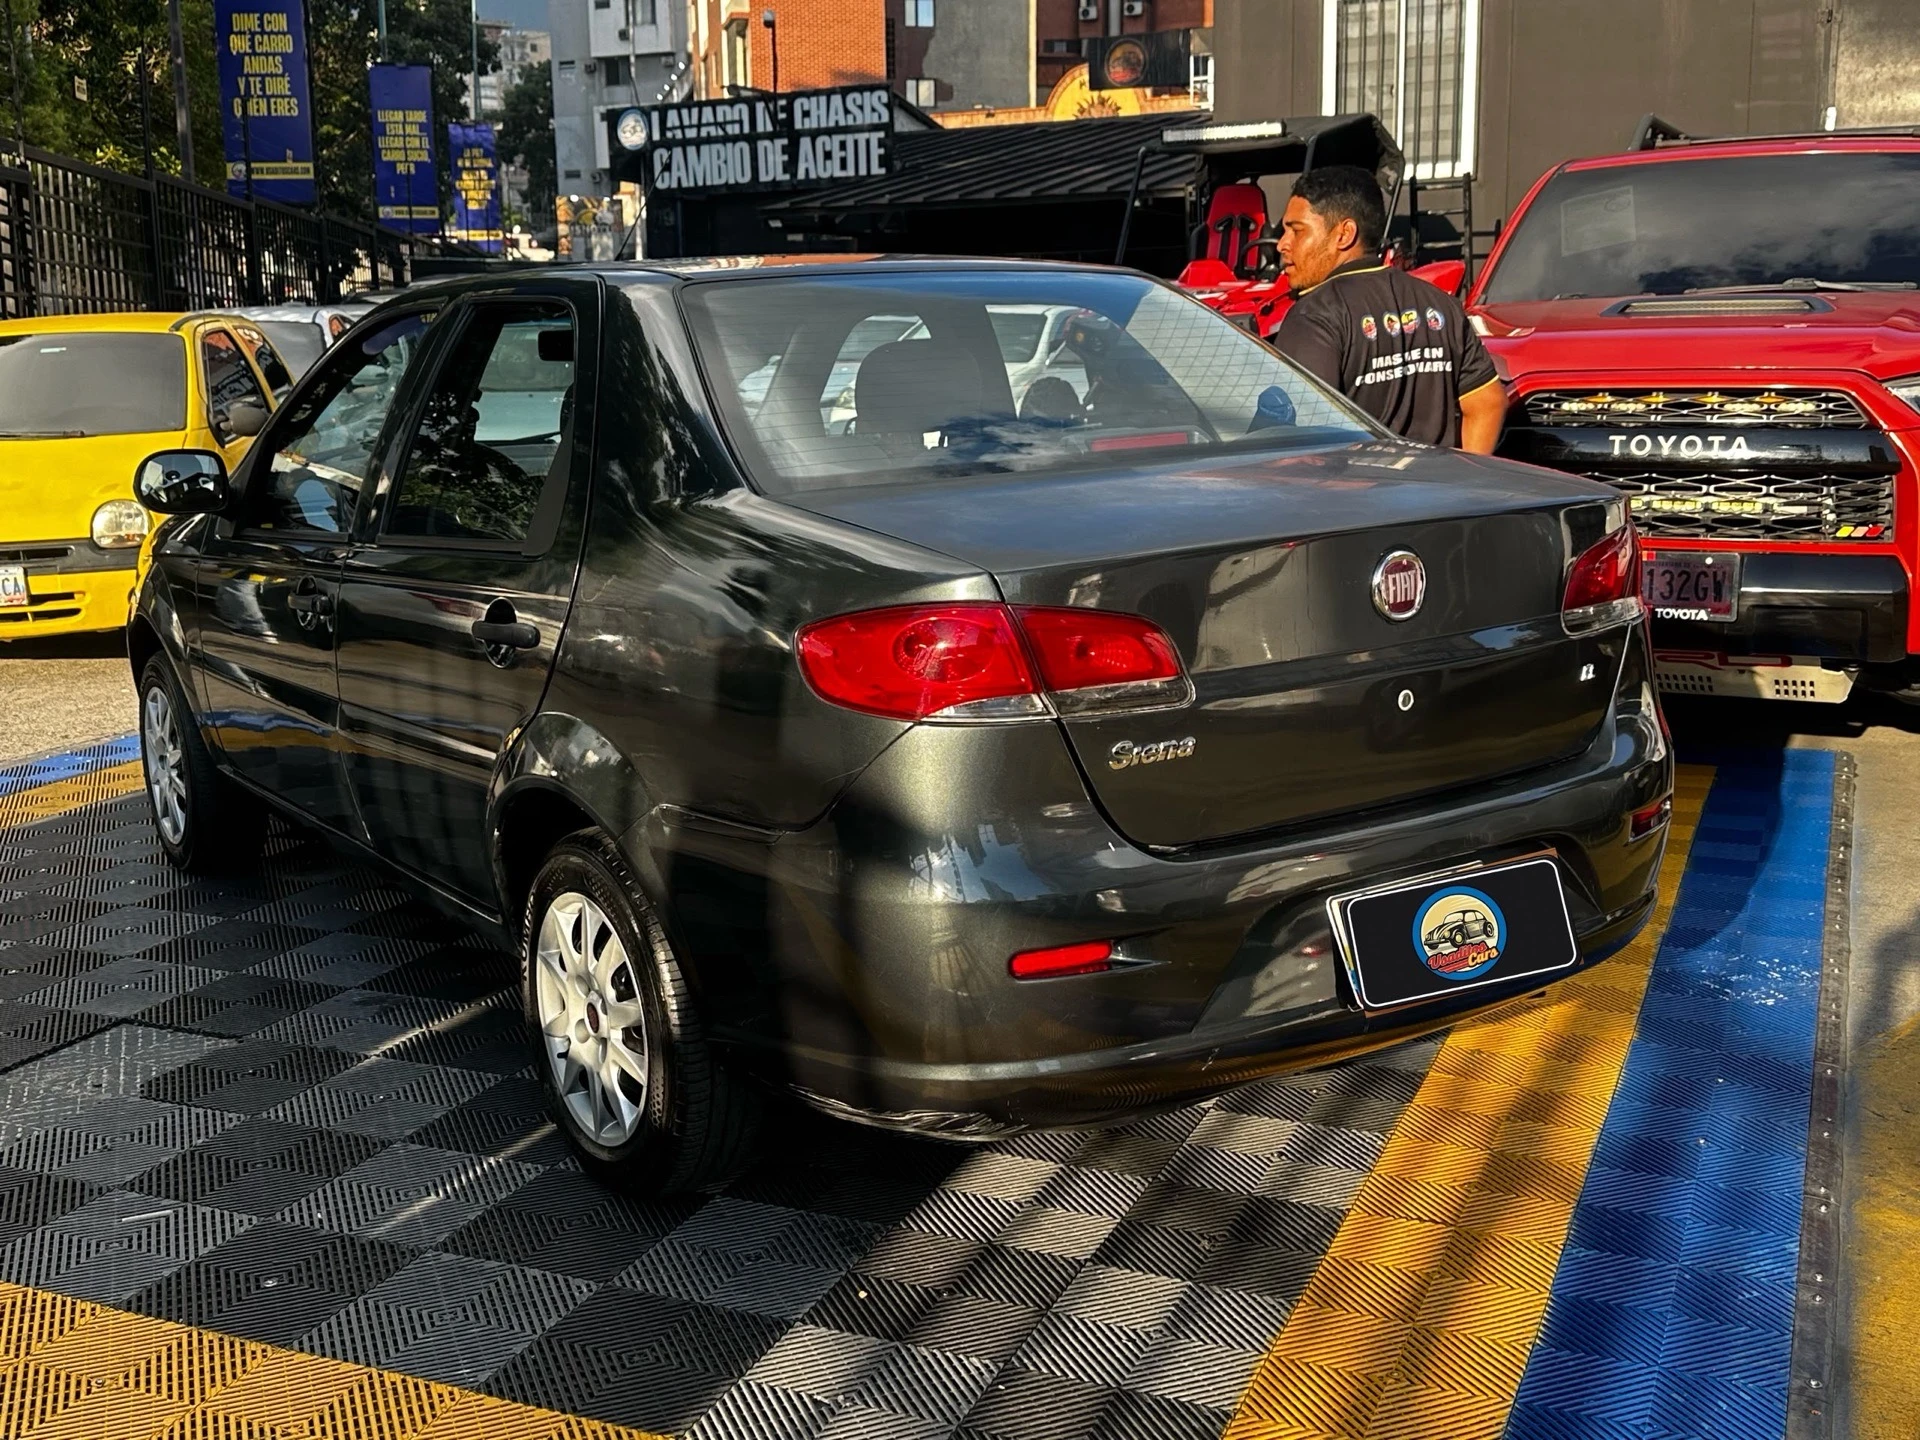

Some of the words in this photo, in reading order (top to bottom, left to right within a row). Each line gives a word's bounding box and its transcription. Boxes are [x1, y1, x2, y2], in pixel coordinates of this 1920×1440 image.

[232, 13, 261, 32] DIME
[263, 13, 288, 32] CON
[254, 34, 294, 54] CARRO
[243, 55, 283, 75] ANDAS
[237, 77, 246, 96] Y
[248, 77, 263, 95] TE
[264, 72, 292, 95] DIRÉ
[233, 95, 268, 118] QIÉN
[270, 97, 299, 117] ERES
[377, 110, 404, 122] LLEGAR
[793, 89, 890, 130] CHASIS
[378, 136, 404, 149] LLEGAR
[405, 136, 421, 149] CON
[421, 136, 430, 149] EL
[381, 149, 406, 162] CARRO
[653, 140, 752, 190] CAMBIO
[757, 138, 791, 183] DE
[797, 131, 887, 180] ACEITE
[1608, 434, 1750, 460] TOYOTA
[1387, 569, 1417, 604] FIAT
[1655, 608, 1709, 620] TOYOTA
[1108, 736, 1196, 770] Siena
